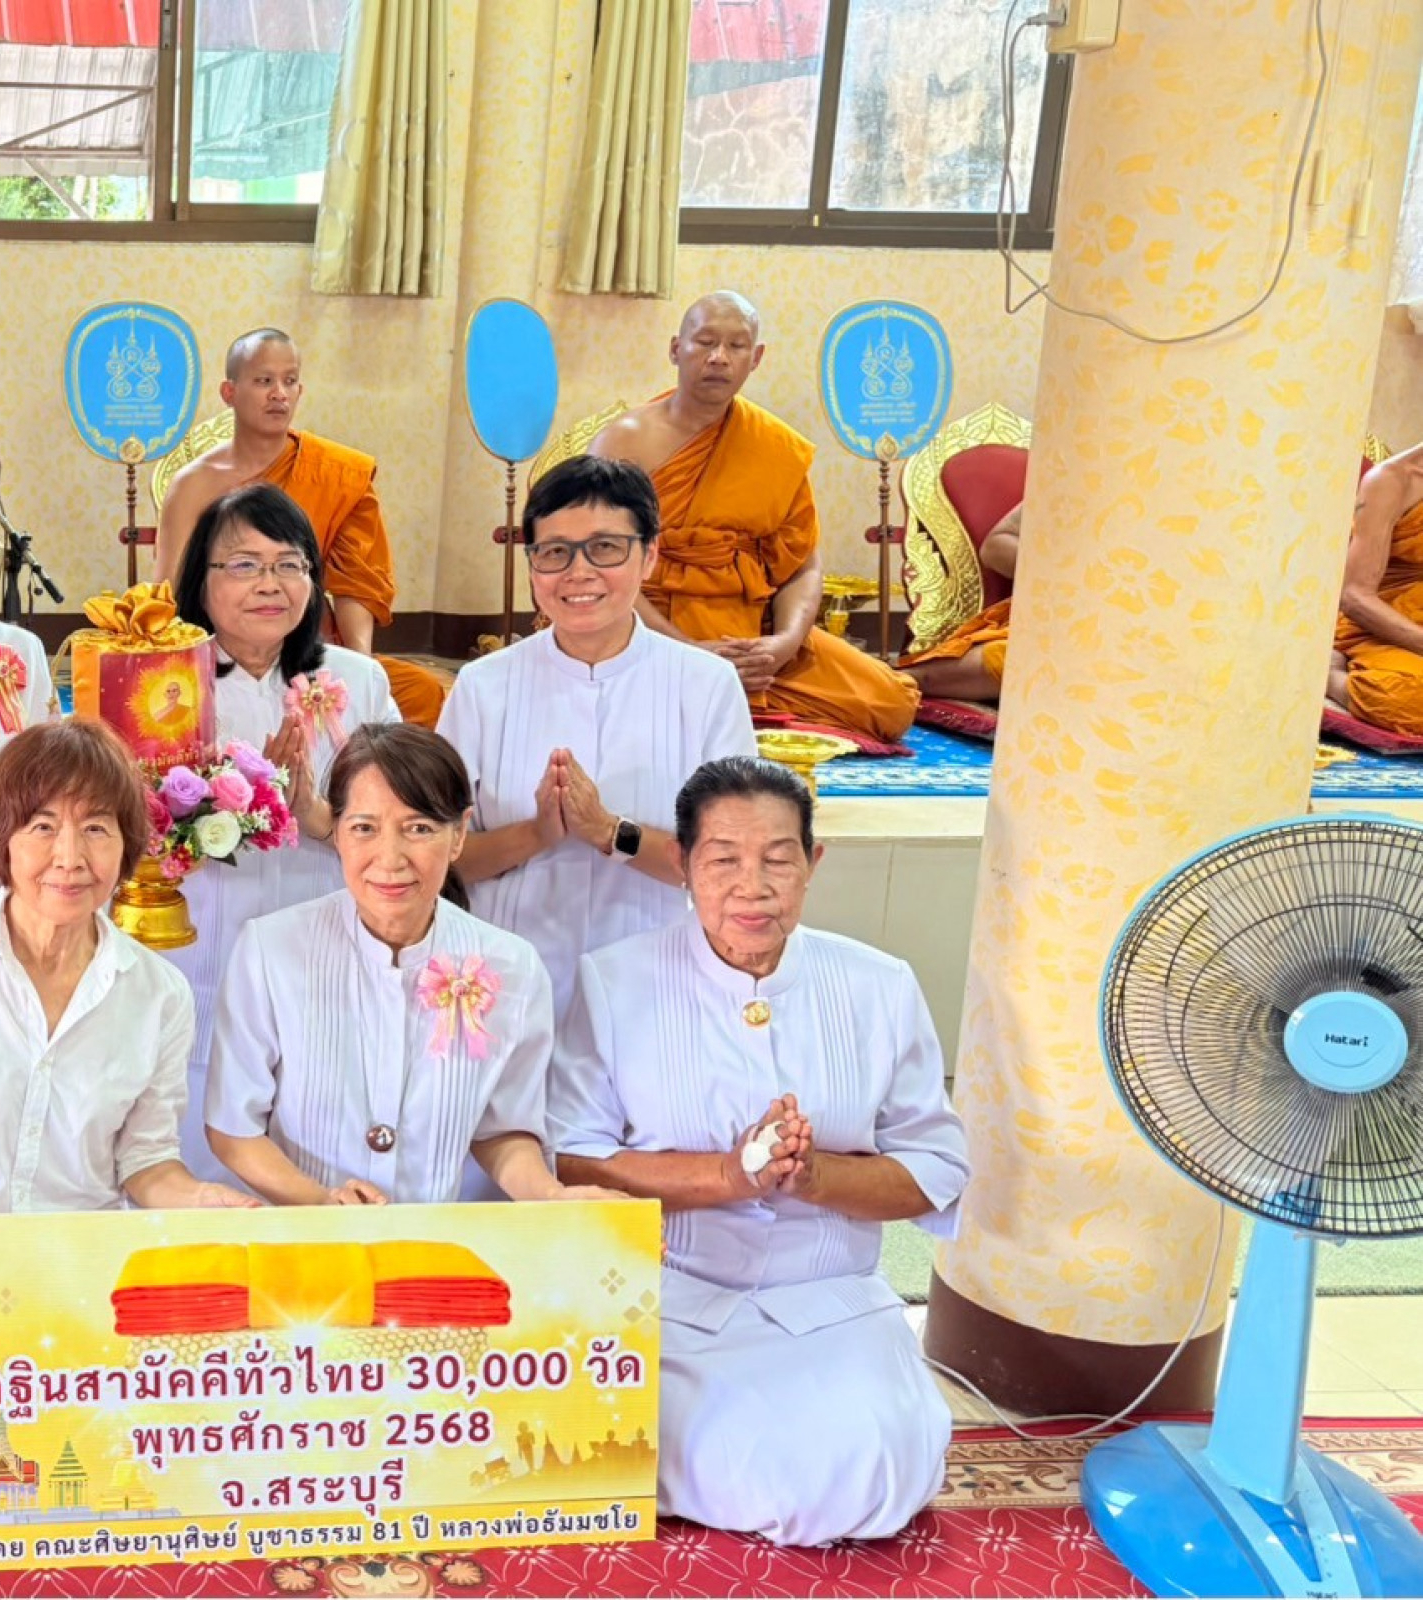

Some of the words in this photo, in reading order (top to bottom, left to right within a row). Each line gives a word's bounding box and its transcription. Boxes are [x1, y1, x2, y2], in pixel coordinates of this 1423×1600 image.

[407, 1352, 568, 1395] 30,000
[587, 1341, 641, 1384] วัด
[133, 1411, 366, 1469] พุทธศักราช
[386, 1411, 491, 1446] 2568
[221, 1458, 404, 1517] จ.สระบุรี
[35, 1521, 237, 1558] คณะศิษยานุศิษย์
[247, 1527, 362, 1554] บูชาธรรม
[373, 1522, 402, 1541] 81
[412, 1515, 430, 1540] ปี
[440, 1504, 638, 1537] หลวงพ่อธัมมชโย
